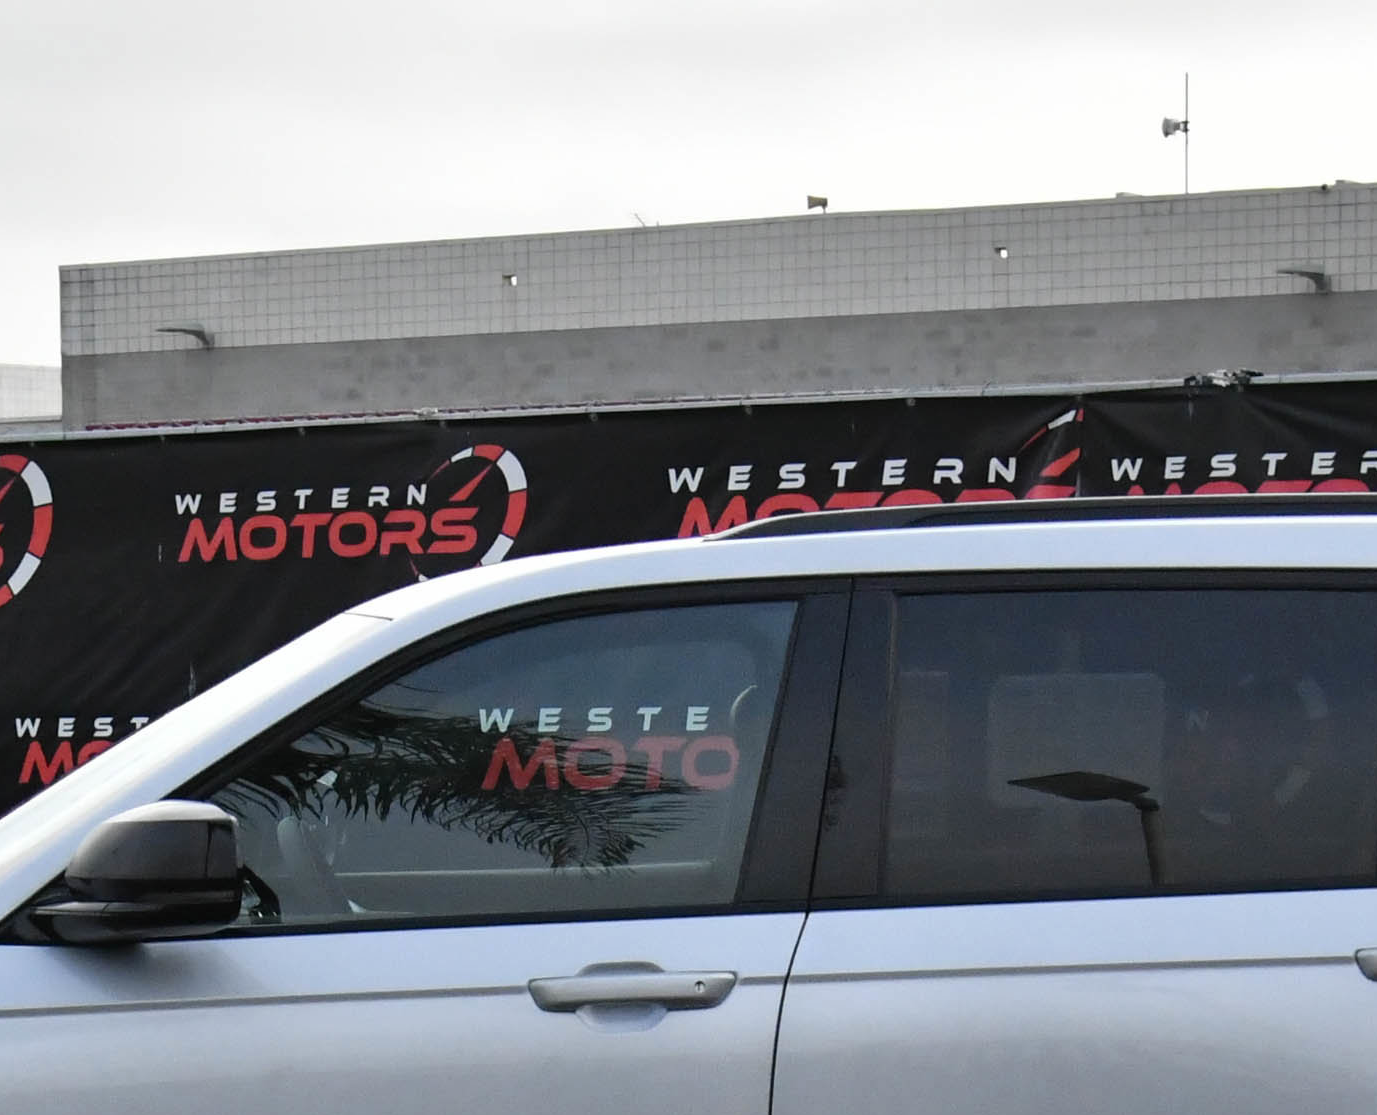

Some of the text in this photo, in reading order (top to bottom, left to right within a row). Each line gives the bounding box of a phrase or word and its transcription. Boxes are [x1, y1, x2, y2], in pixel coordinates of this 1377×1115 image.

[668, 457, 1017, 494] WESTERN
[175, 483, 427, 515] WESTERN
[178, 506, 479, 563] MOTORS
